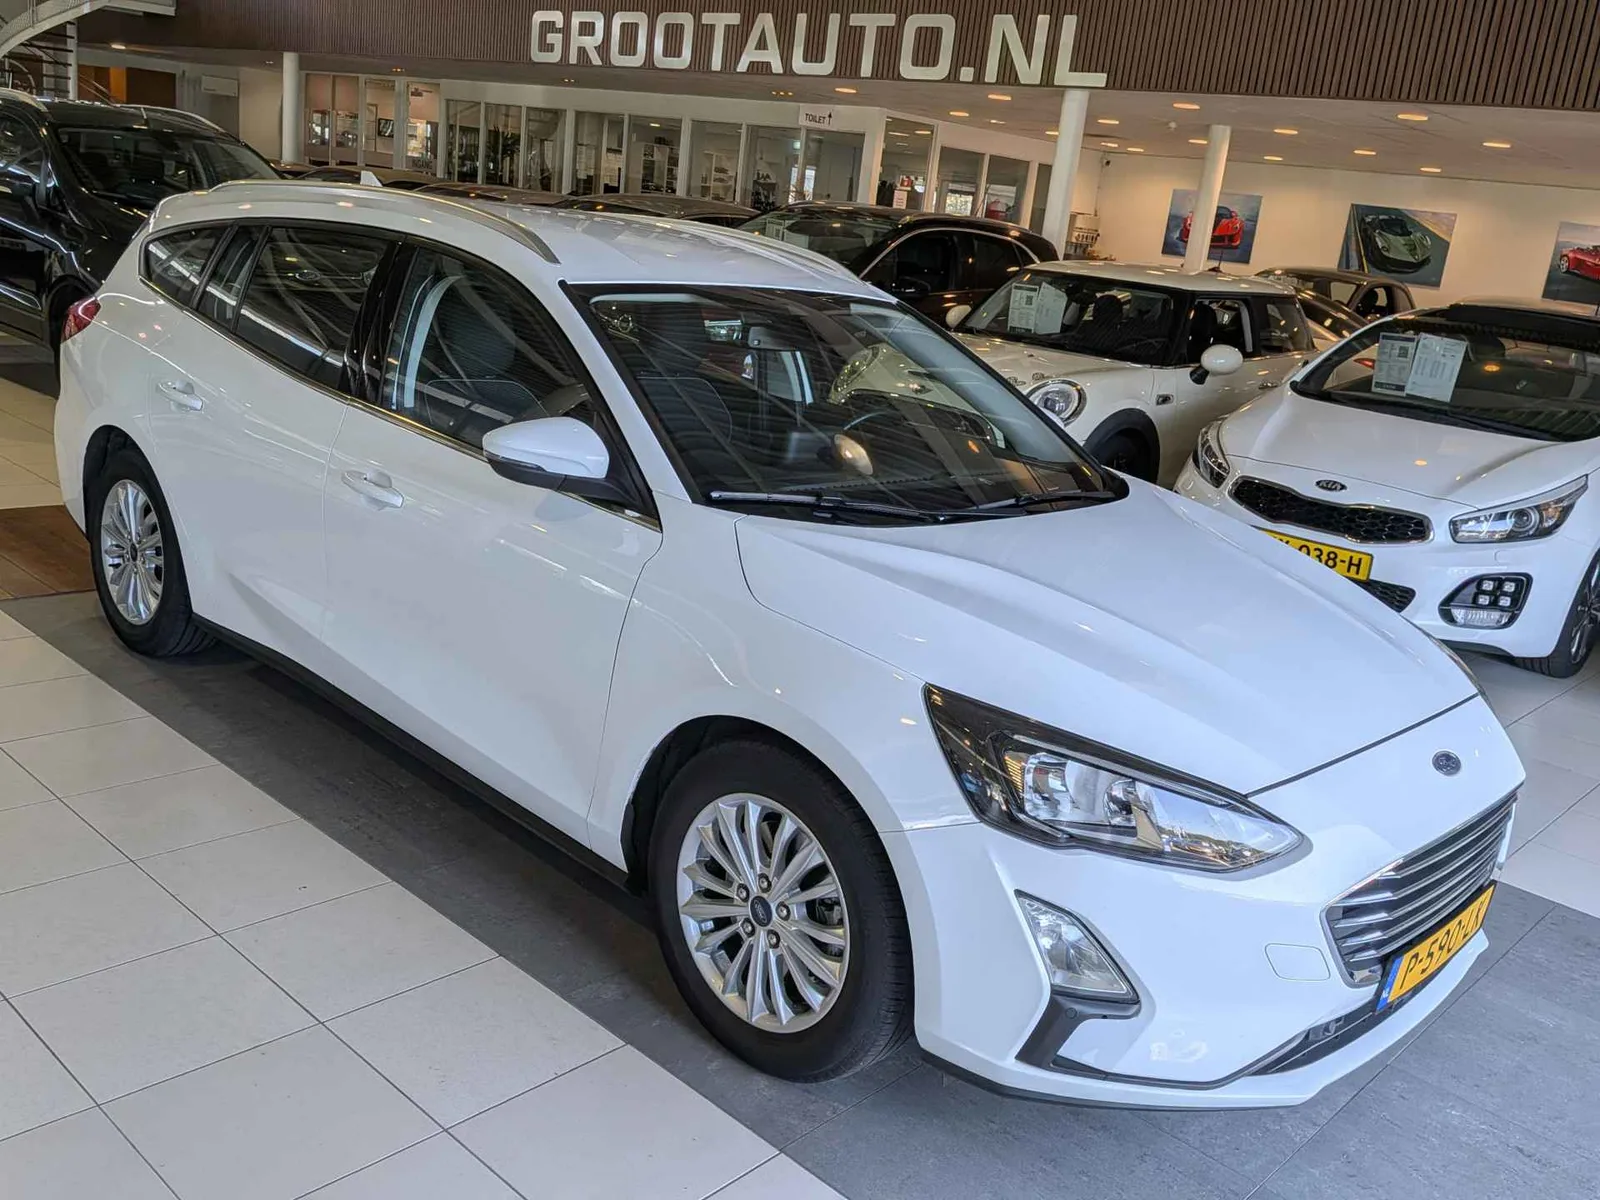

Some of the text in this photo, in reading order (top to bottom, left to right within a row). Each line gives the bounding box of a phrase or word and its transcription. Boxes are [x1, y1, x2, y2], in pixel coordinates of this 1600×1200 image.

[530, 10, 1107, 87] GROOTAUTO.NL
[805, 113, 826, 124] TOILET
[1318, 480, 1342, 491] KIA
